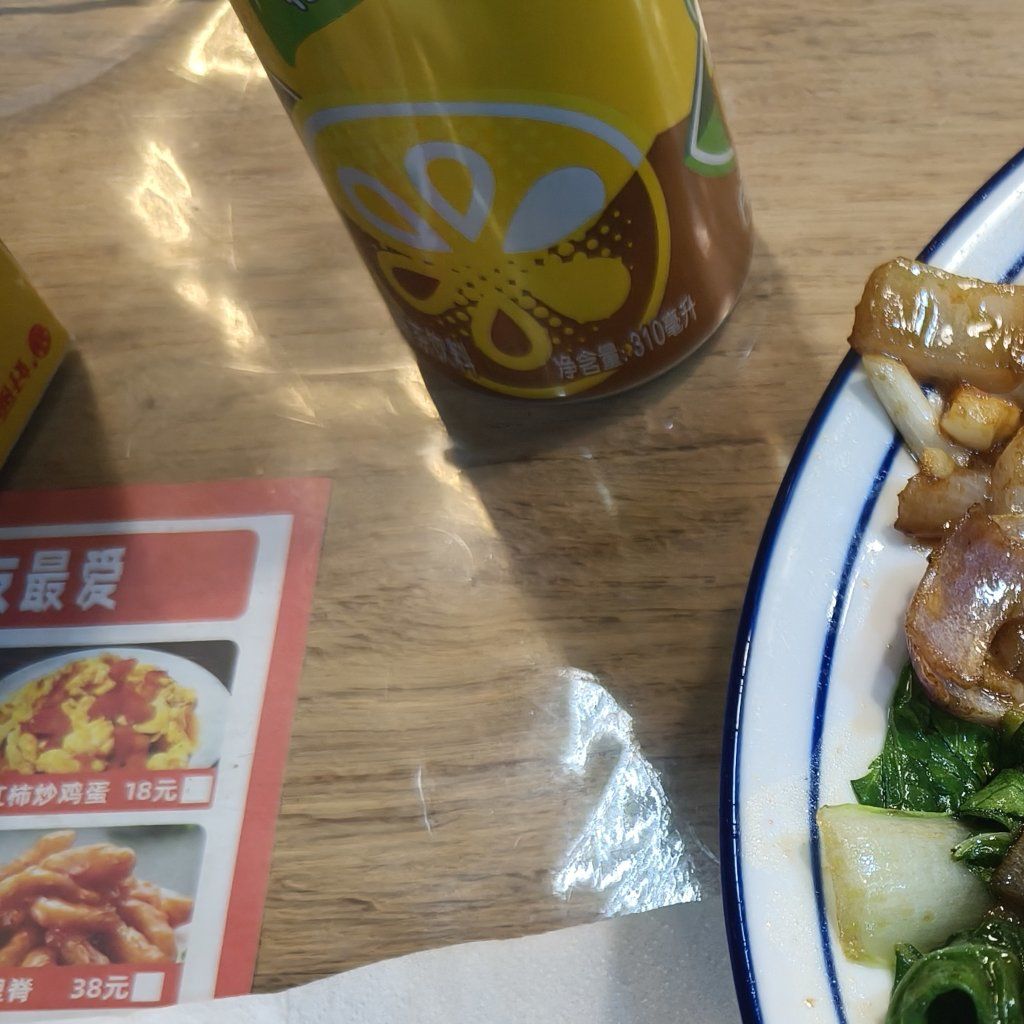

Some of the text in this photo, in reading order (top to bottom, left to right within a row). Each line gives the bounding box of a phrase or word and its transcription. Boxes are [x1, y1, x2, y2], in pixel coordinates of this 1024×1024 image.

[0, 780, 178, 807] 柿炒鸡蛋 18元
[0, 975, 129, 1003] 脊 38元
